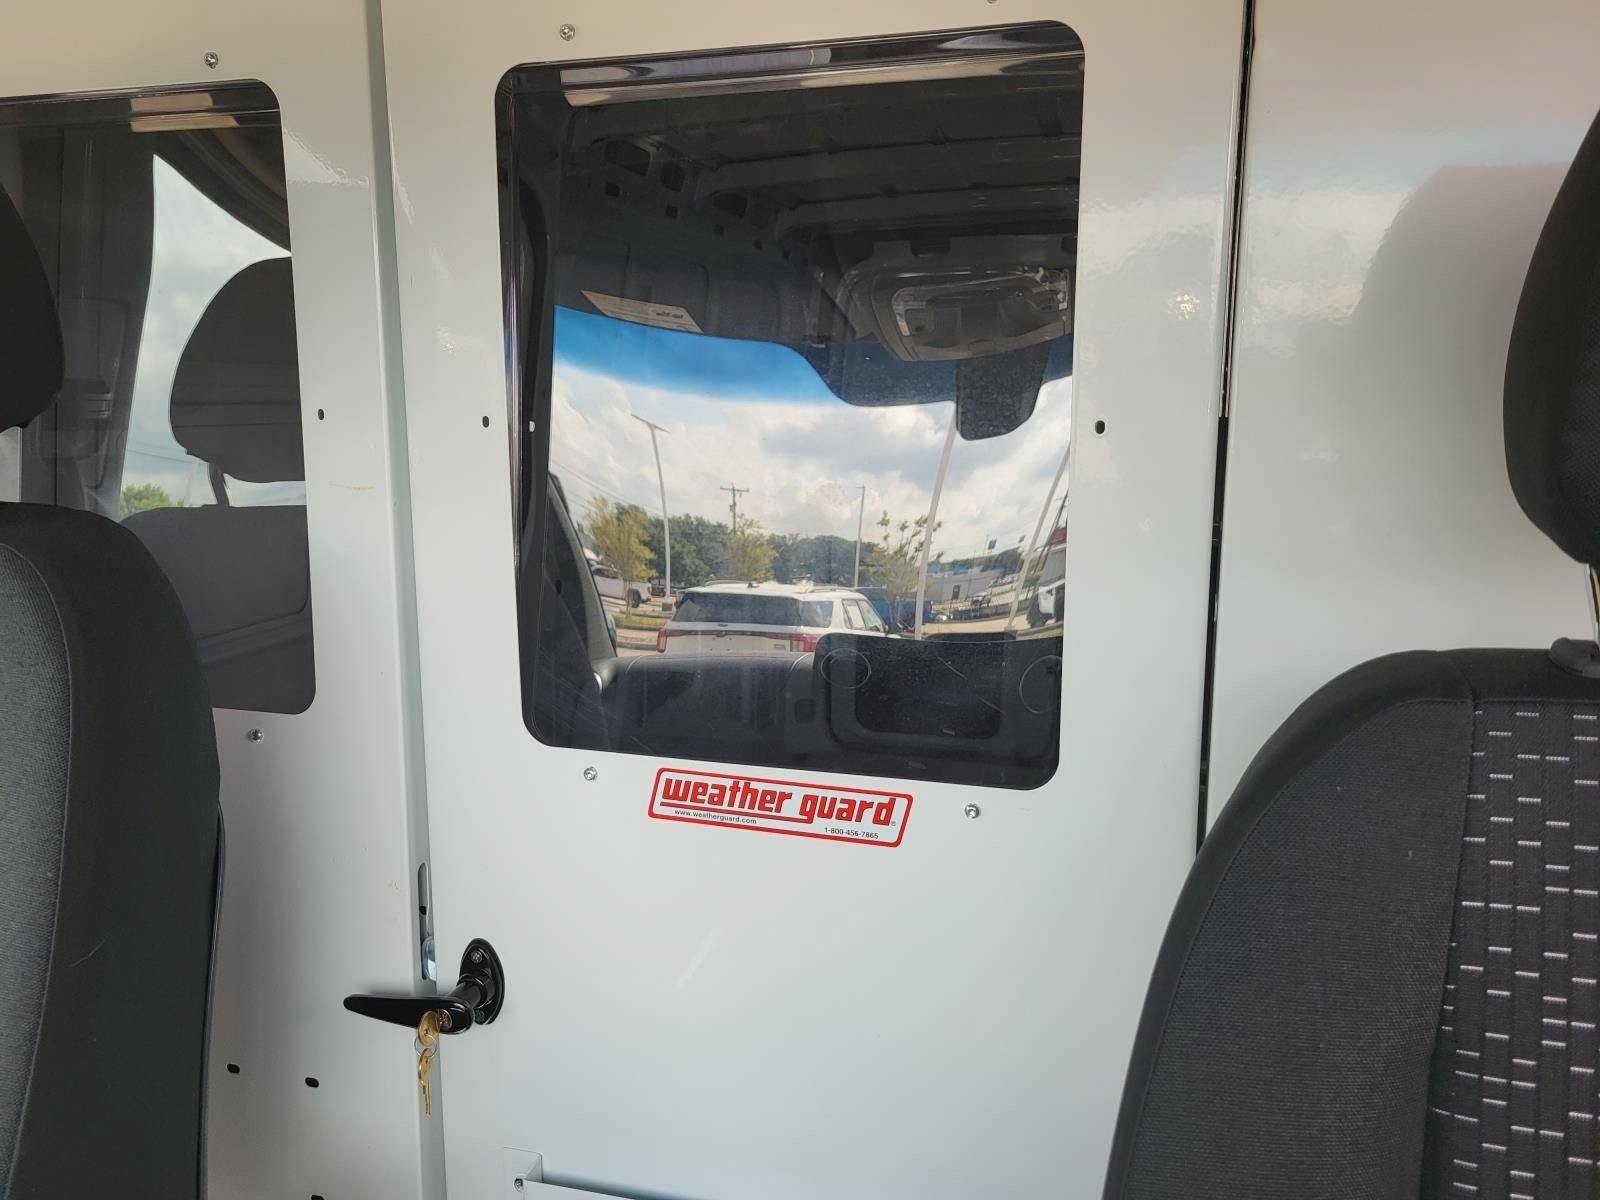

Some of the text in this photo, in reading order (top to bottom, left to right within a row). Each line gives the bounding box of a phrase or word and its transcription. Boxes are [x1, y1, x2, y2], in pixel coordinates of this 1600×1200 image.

[662, 778, 793, 813] weather
[674, 809, 757, 825] www.weatherguard.com
[824, 826, 880, 840] 1-800-456-7865
